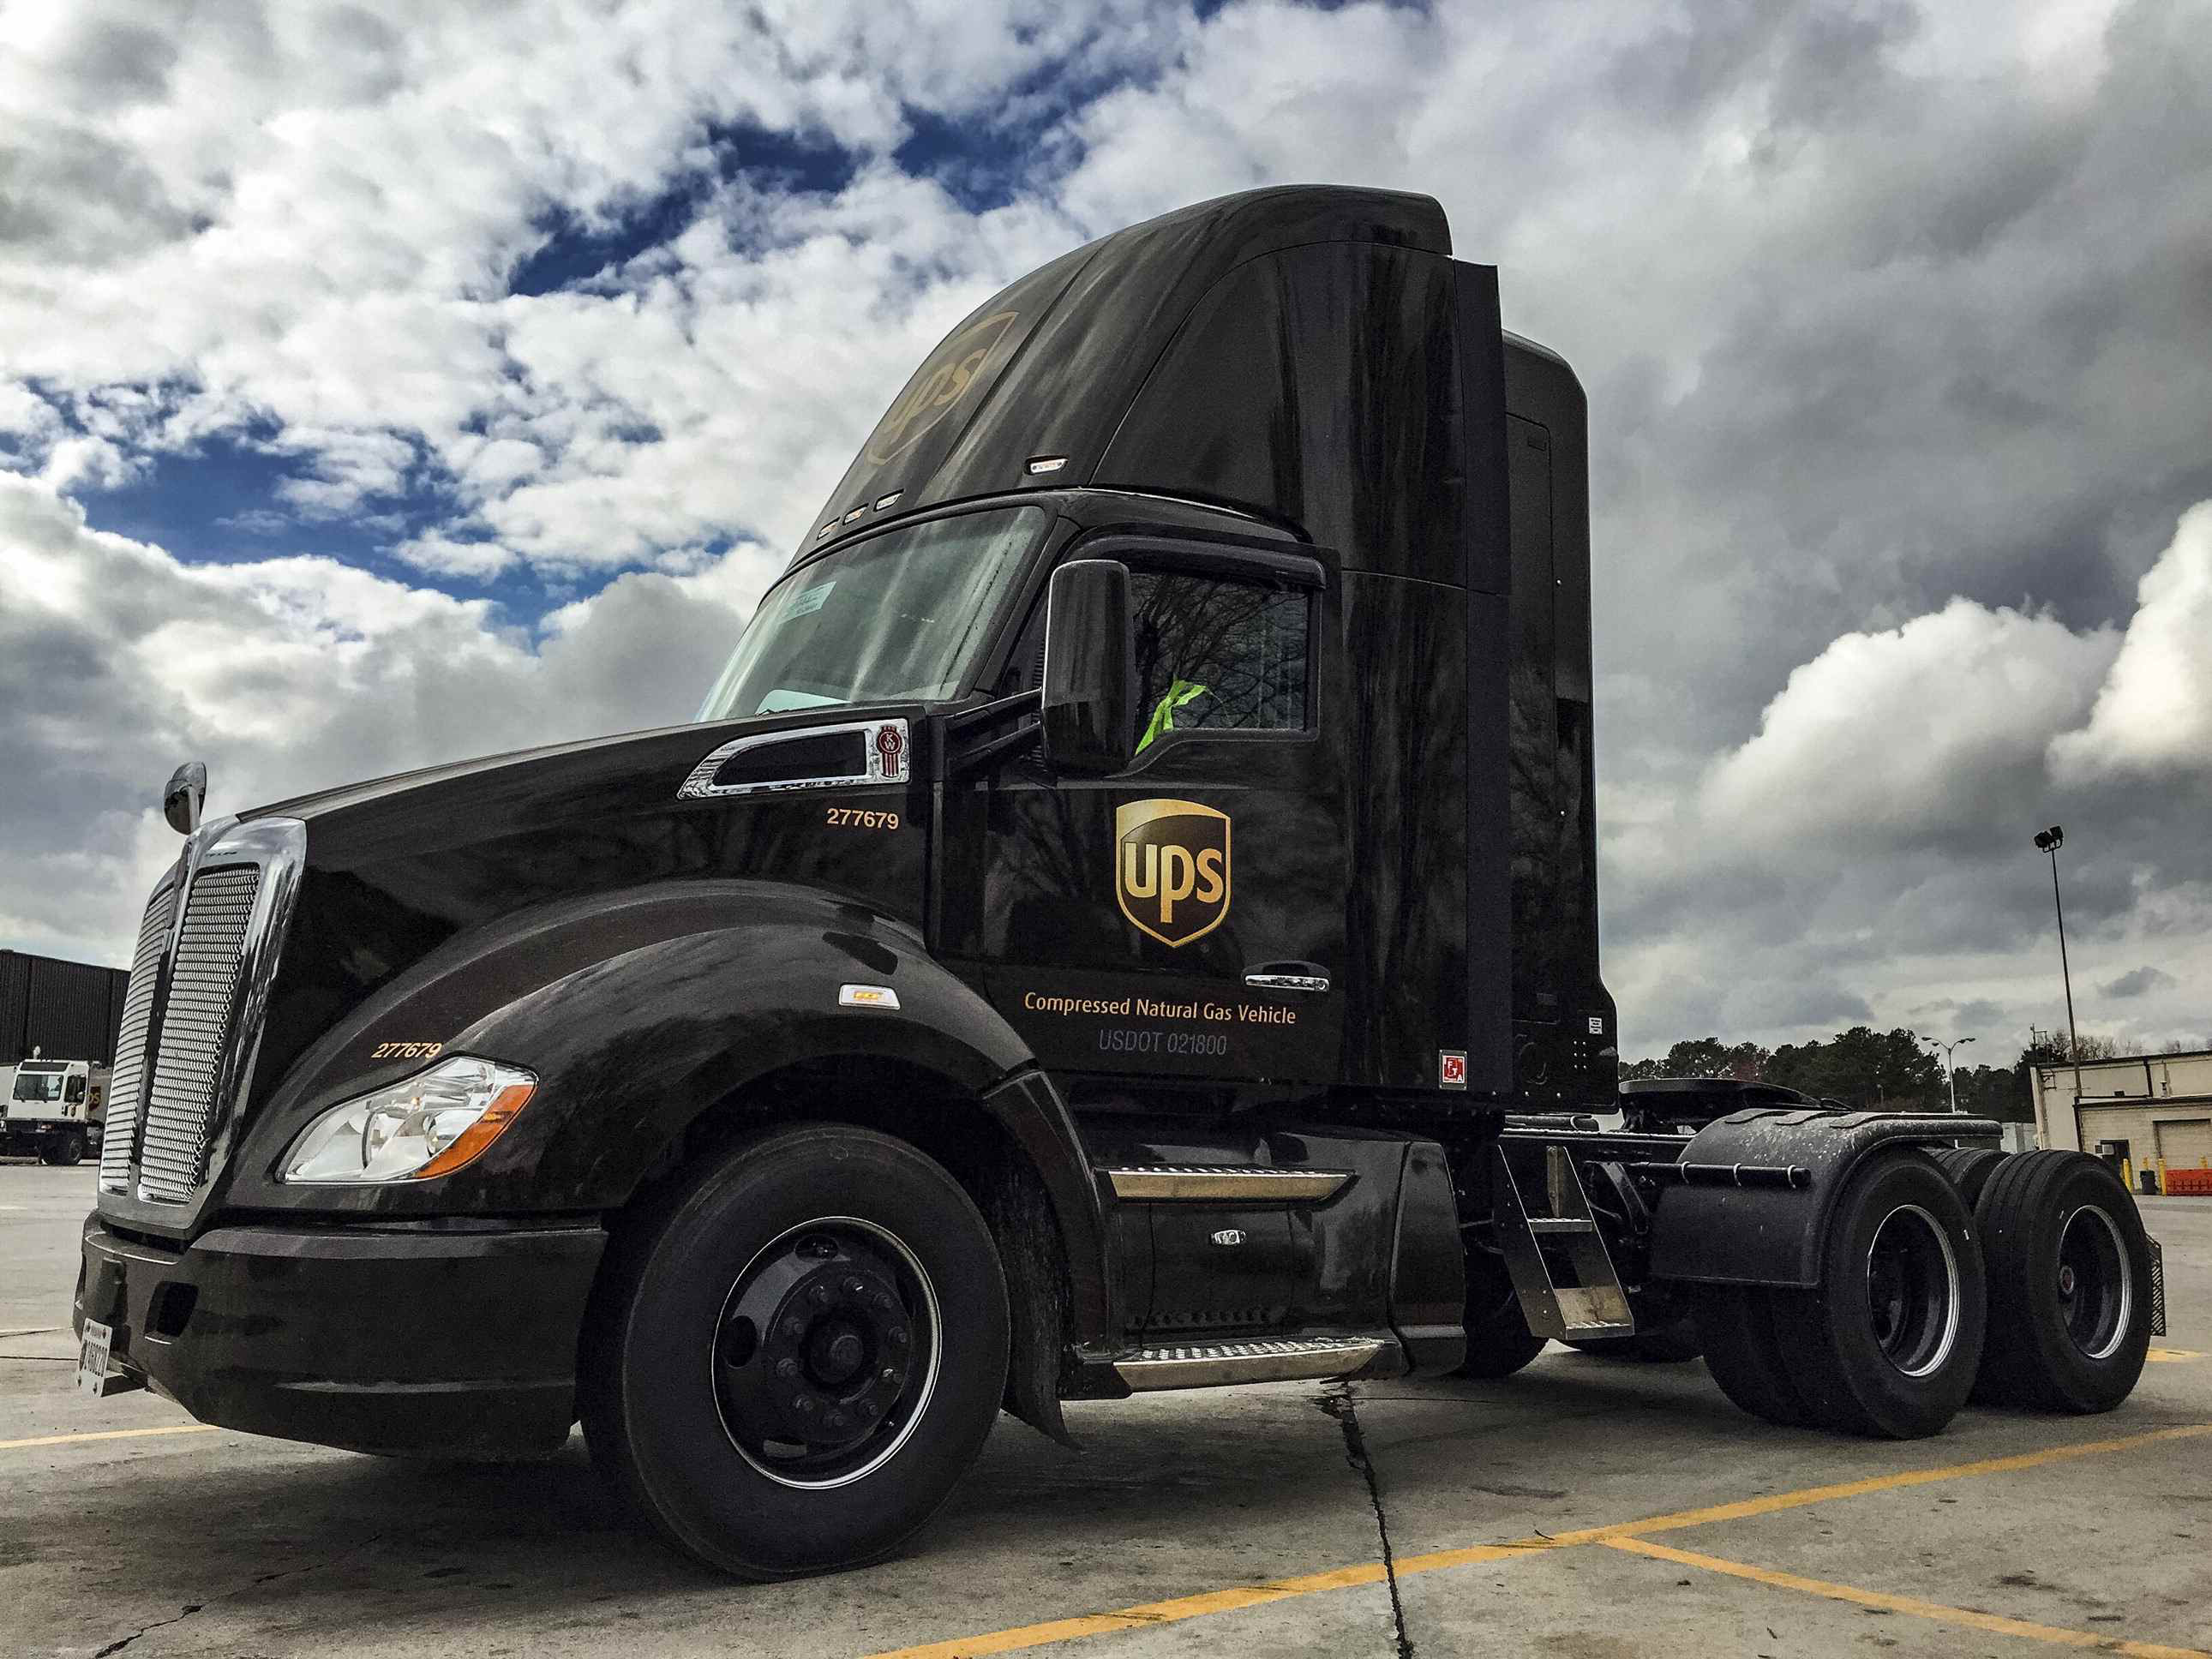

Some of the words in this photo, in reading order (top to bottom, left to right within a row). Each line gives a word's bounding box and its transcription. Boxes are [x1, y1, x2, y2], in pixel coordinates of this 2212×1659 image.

[827, 808, 899, 830] 277679
[1124, 842, 1223, 923] ups
[1024, 991, 1130, 1016] Compressed
[1136, 998, 1198, 1019] Natural
[1203, 1003, 1232, 1021] Gas
[1238, 1003, 1296, 1024] Vehicle
[370, 1042, 442, 1058] 277679
[1099, 1029, 1163, 1052] USDOT
[1167, 1033, 1227, 1055] 021800
